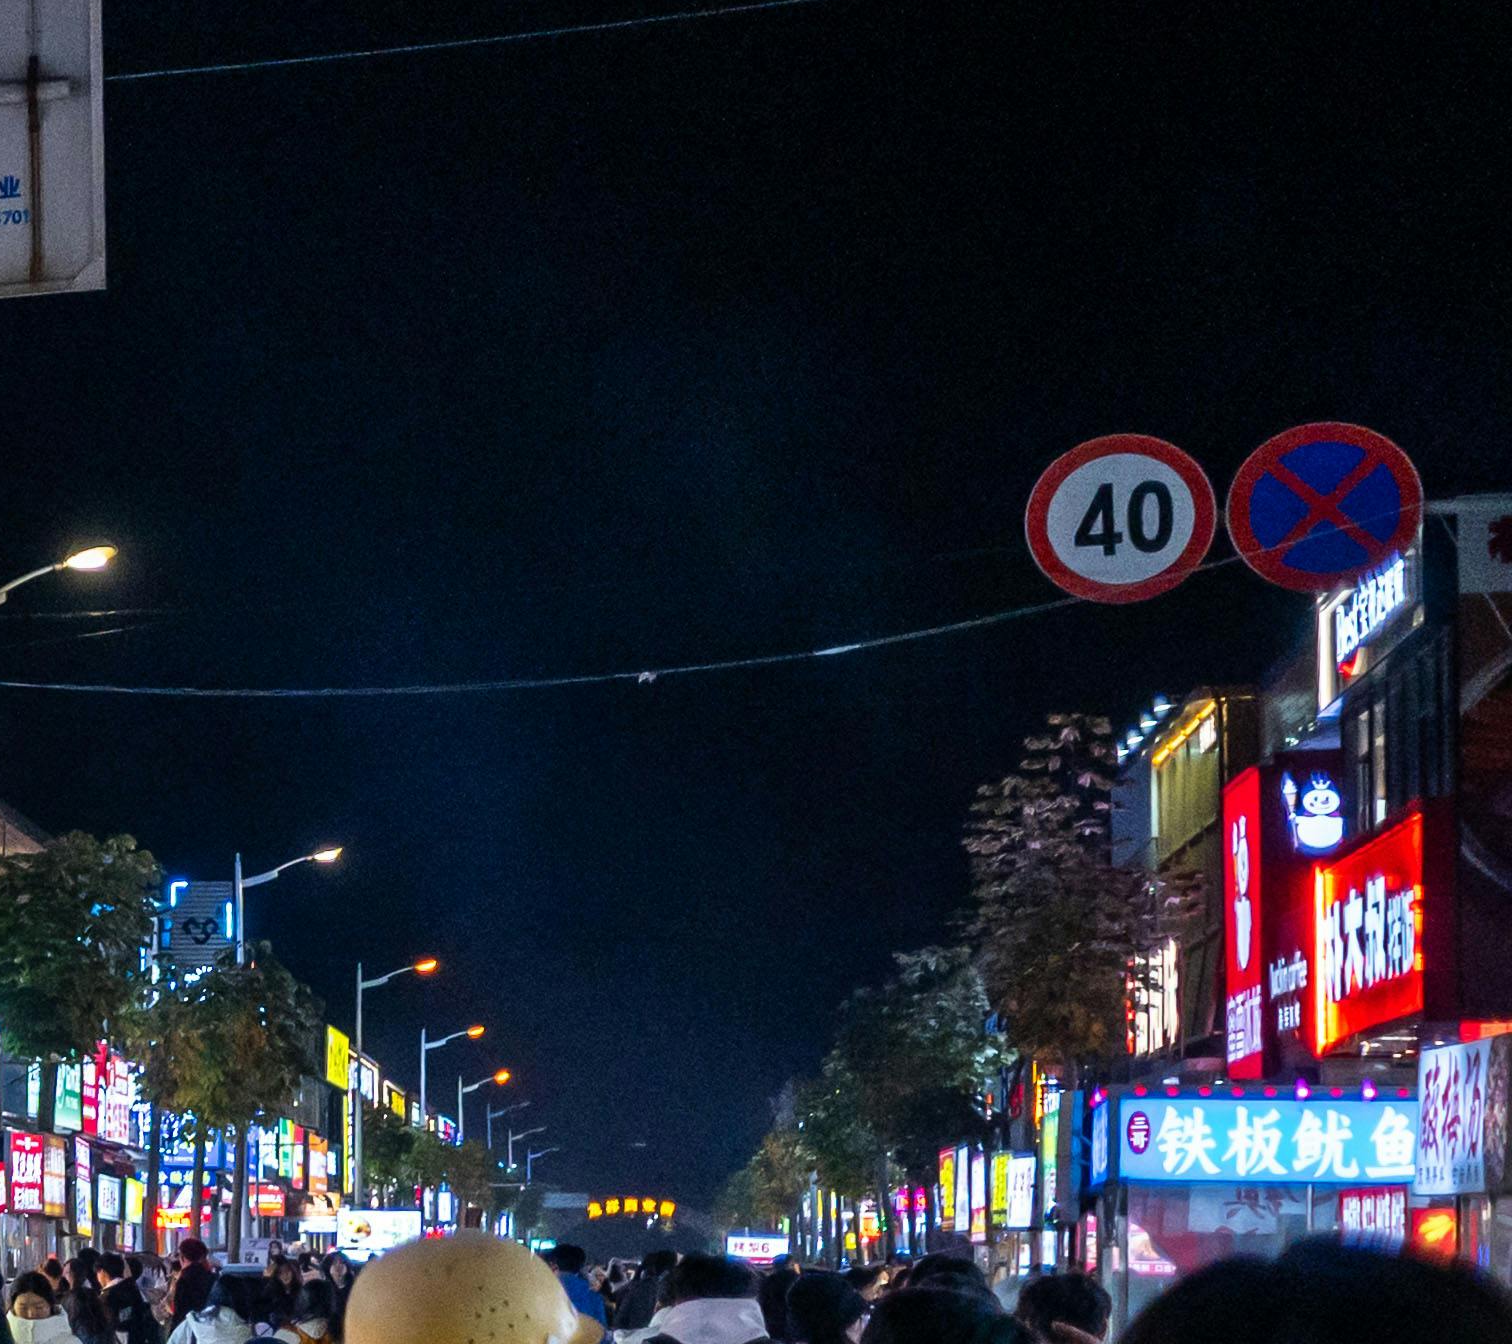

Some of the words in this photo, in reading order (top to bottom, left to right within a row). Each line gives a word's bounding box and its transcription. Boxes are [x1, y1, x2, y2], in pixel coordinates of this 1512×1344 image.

[1074, 480, 1174, 556] 40
[1156, 1105, 1416, 1179] 铁板鱿鱼
